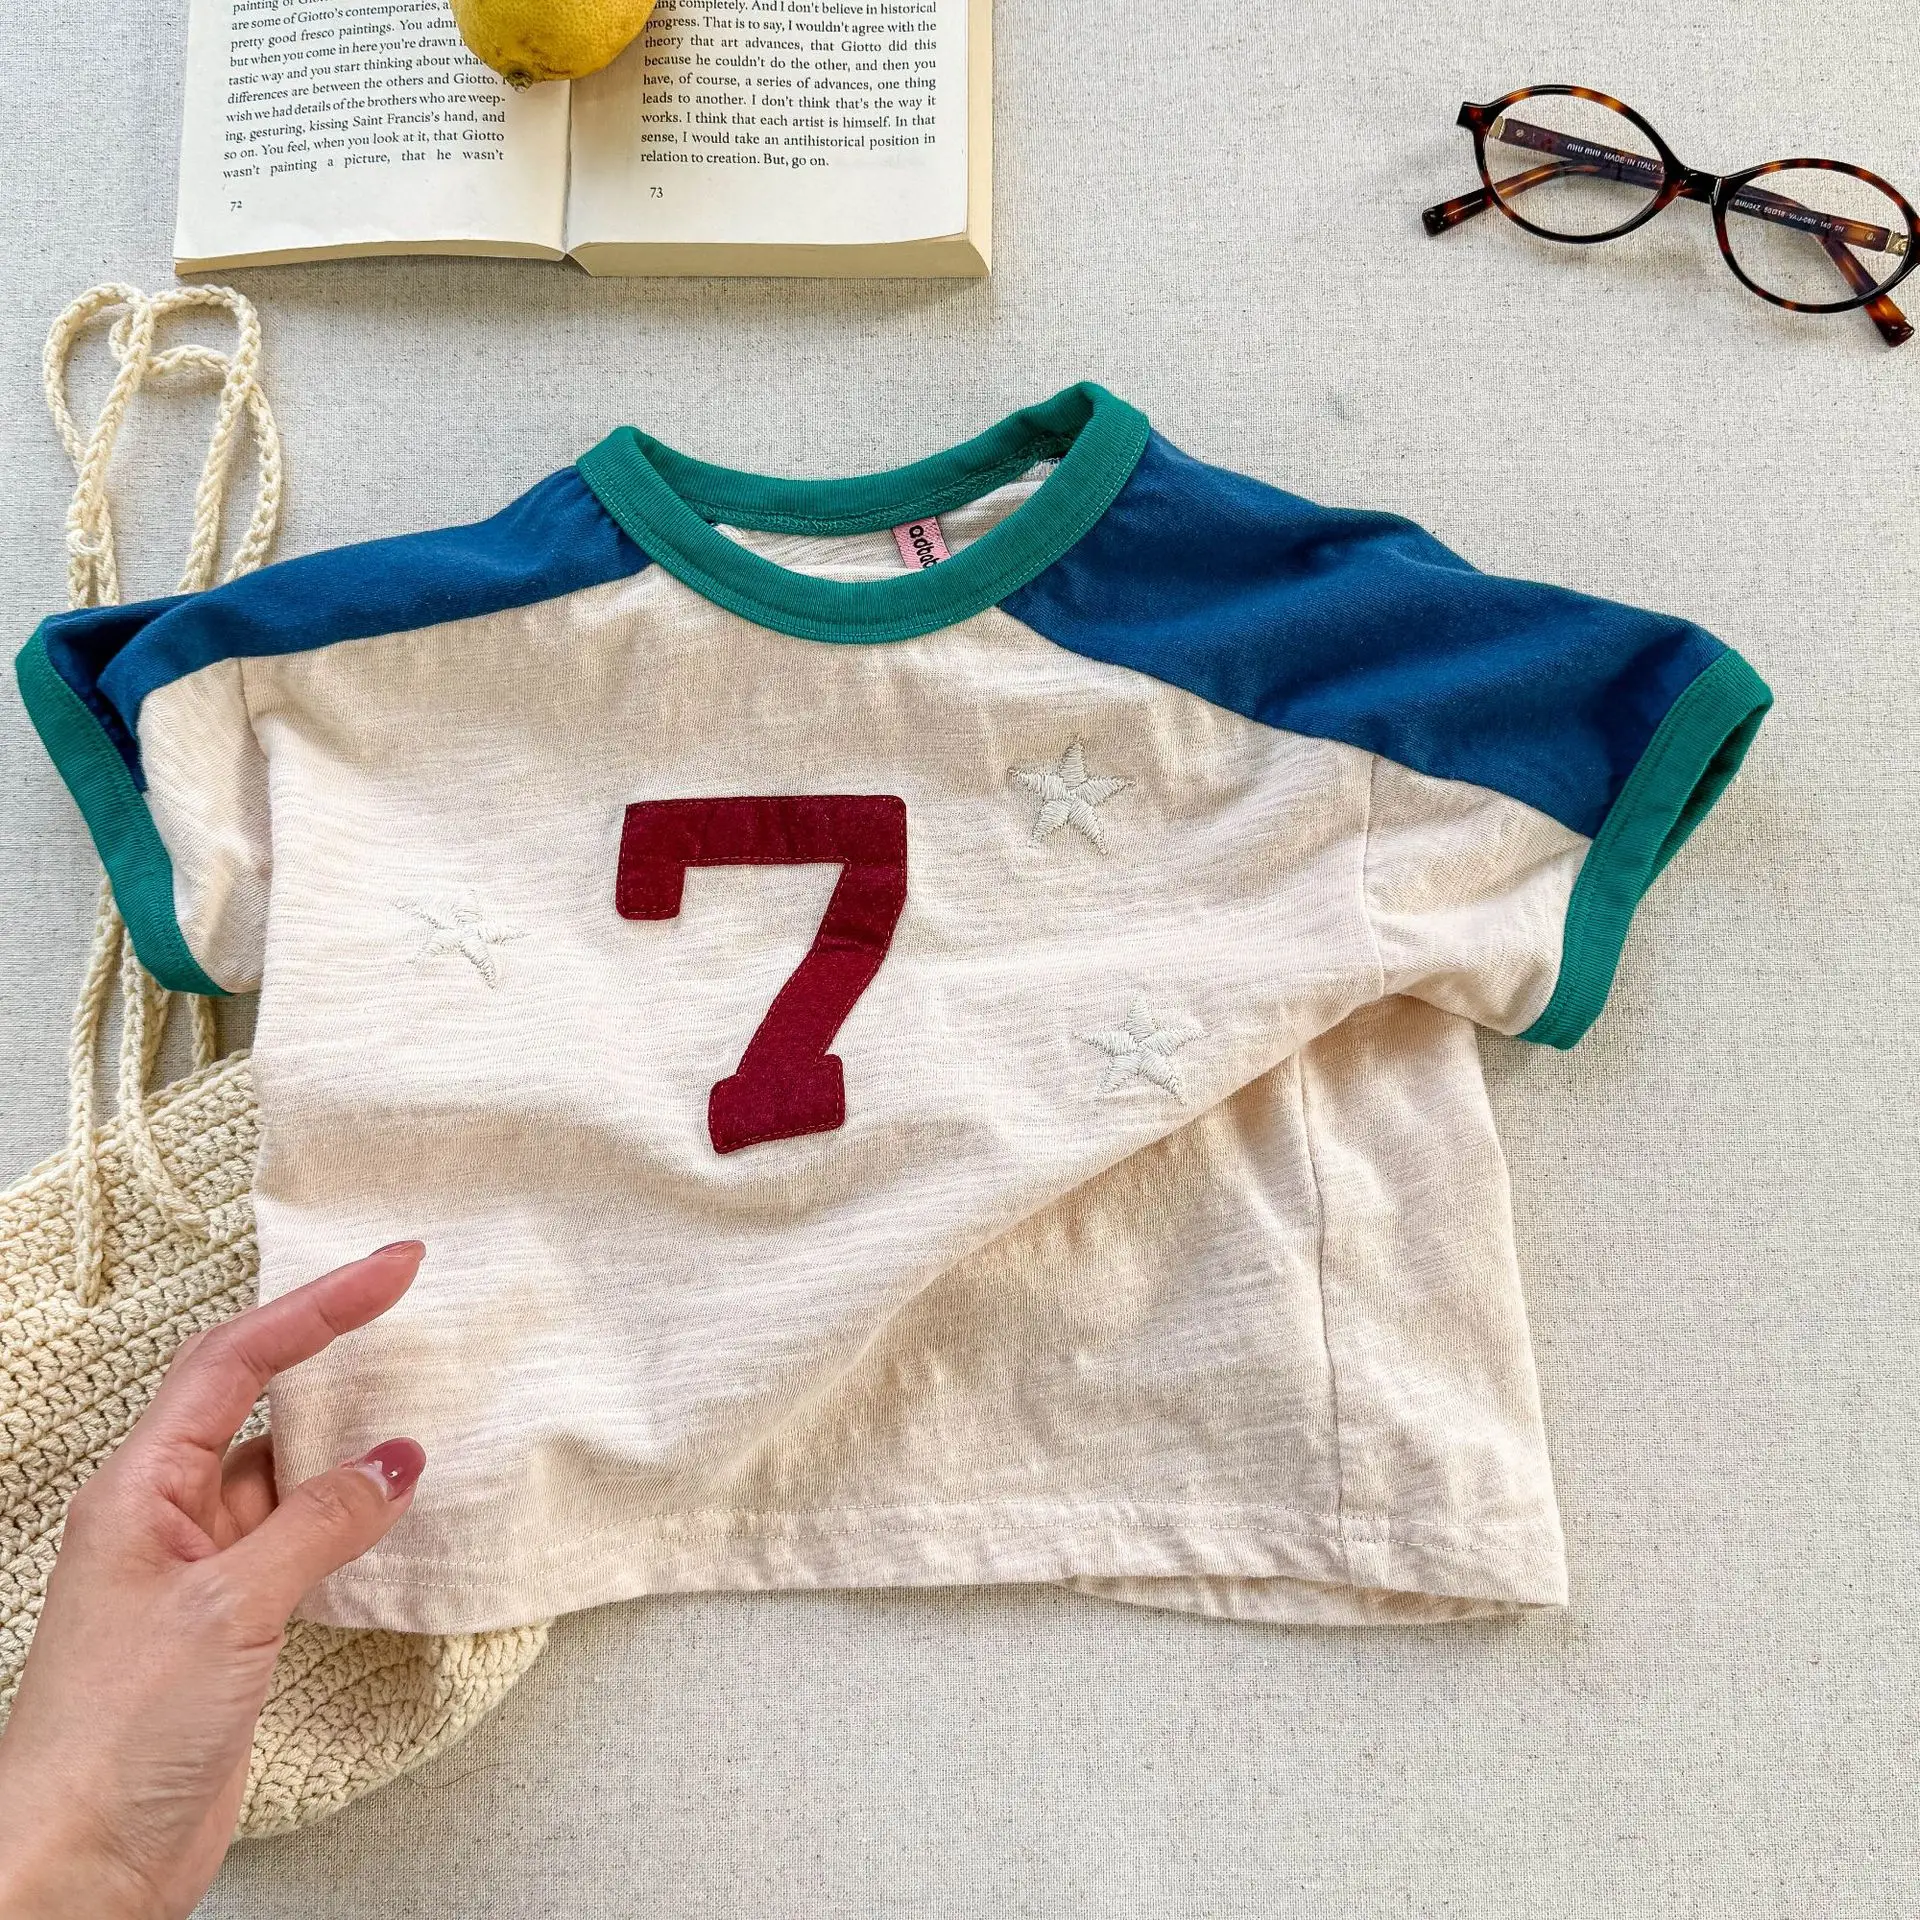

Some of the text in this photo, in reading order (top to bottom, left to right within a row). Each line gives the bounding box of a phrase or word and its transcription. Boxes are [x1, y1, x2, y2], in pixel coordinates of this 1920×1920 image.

[232, 21, 249, 30] are
[251, 18, 281, 28] some
[283, 14, 297, 24] of
[298, 8, 343, 22] Giotto's
[345, 2, 440, 17] contemporaries,
[679, 0, 748, 14] completely.
[752, 0, 777, 11] And
[780, 1, 784, 12] I
[788, 1, 819, 13] don't
[822, 2, 863, 14] believe
[866, 4, 877, 14] in
[881, 1, 936, 14] historical
[231, 38, 264, 52] pretty
[268, 31, 296, 48] good
[301, 29, 334, 41] fresco
[339, 23, 394, 40] paintings.
[400, 19, 422, 30] You
[646, 16, 936, 36] progress. That is to say, I wouldn't agree with the
[230, 56, 248, 67] but
[250, 53, 281, 64] when
[282, 52, 303, 65] you
[306, 48, 336, 58] come
[339, 44, 349, 54] in
[352, 42, 378, 53] here
[379, 38, 416, 54] you're
[418, 36, 456, 48] drawn
[646, 34, 936, 52] theory that art advances, that Giotto did this
[229, 73, 258, 86] tastic
[261, 73, 284, 84] way
[287, 66, 307, 79] and
[310, 66, 330, 80] you
[334, 63, 360, 73] start
[364, 58, 412, 70] thinking
[416, 55, 450, 66] about
[645, 53, 936, 73] because he couldn't do the other, and then you
[228, 90, 288, 104] differences
[292, 88, 309, 96] are
[313, 82, 360, 94] between
[364, 78, 382, 89] the
[386, 75, 424, 87] others
[427, 73, 449, 84] and
[454, 73, 498, 85] Giotto.
[644, 72, 936, 92] have, of course, a series of advances, one thing
[226, 92, 505, 122] wish we had details of the brothers who are weep-
[643, 91, 936, 110] leads to another. I don't think that's the way it
[226, 110, 505, 143] ing, gesturing, kissing Saint Francis's hand, and
[642, 110, 935, 128] works. I think that each artist is himself. In that
[224, 129, 504, 160] so on. You feel, when you look at it, that Giotto
[641, 131, 935, 150] sense, I would take an antihistorical position in
[223, 164, 260, 178] wasn't
[270, 159, 317, 176] painting
[344, 154, 390, 168] picture,
[402, 150, 426, 161] that
[437, 149, 451, 160] he
[462, 149, 504, 160] wasn't
[641, 150, 829, 169] relation to creation. But, go on.
[1604, 152, 1625, 164] MADE
[1637, 160, 1657, 171] ITALY
[650, 187, 663, 198] 73
[230, 201, 242, 212] 72
[615, 794, 908, 1154] 7
